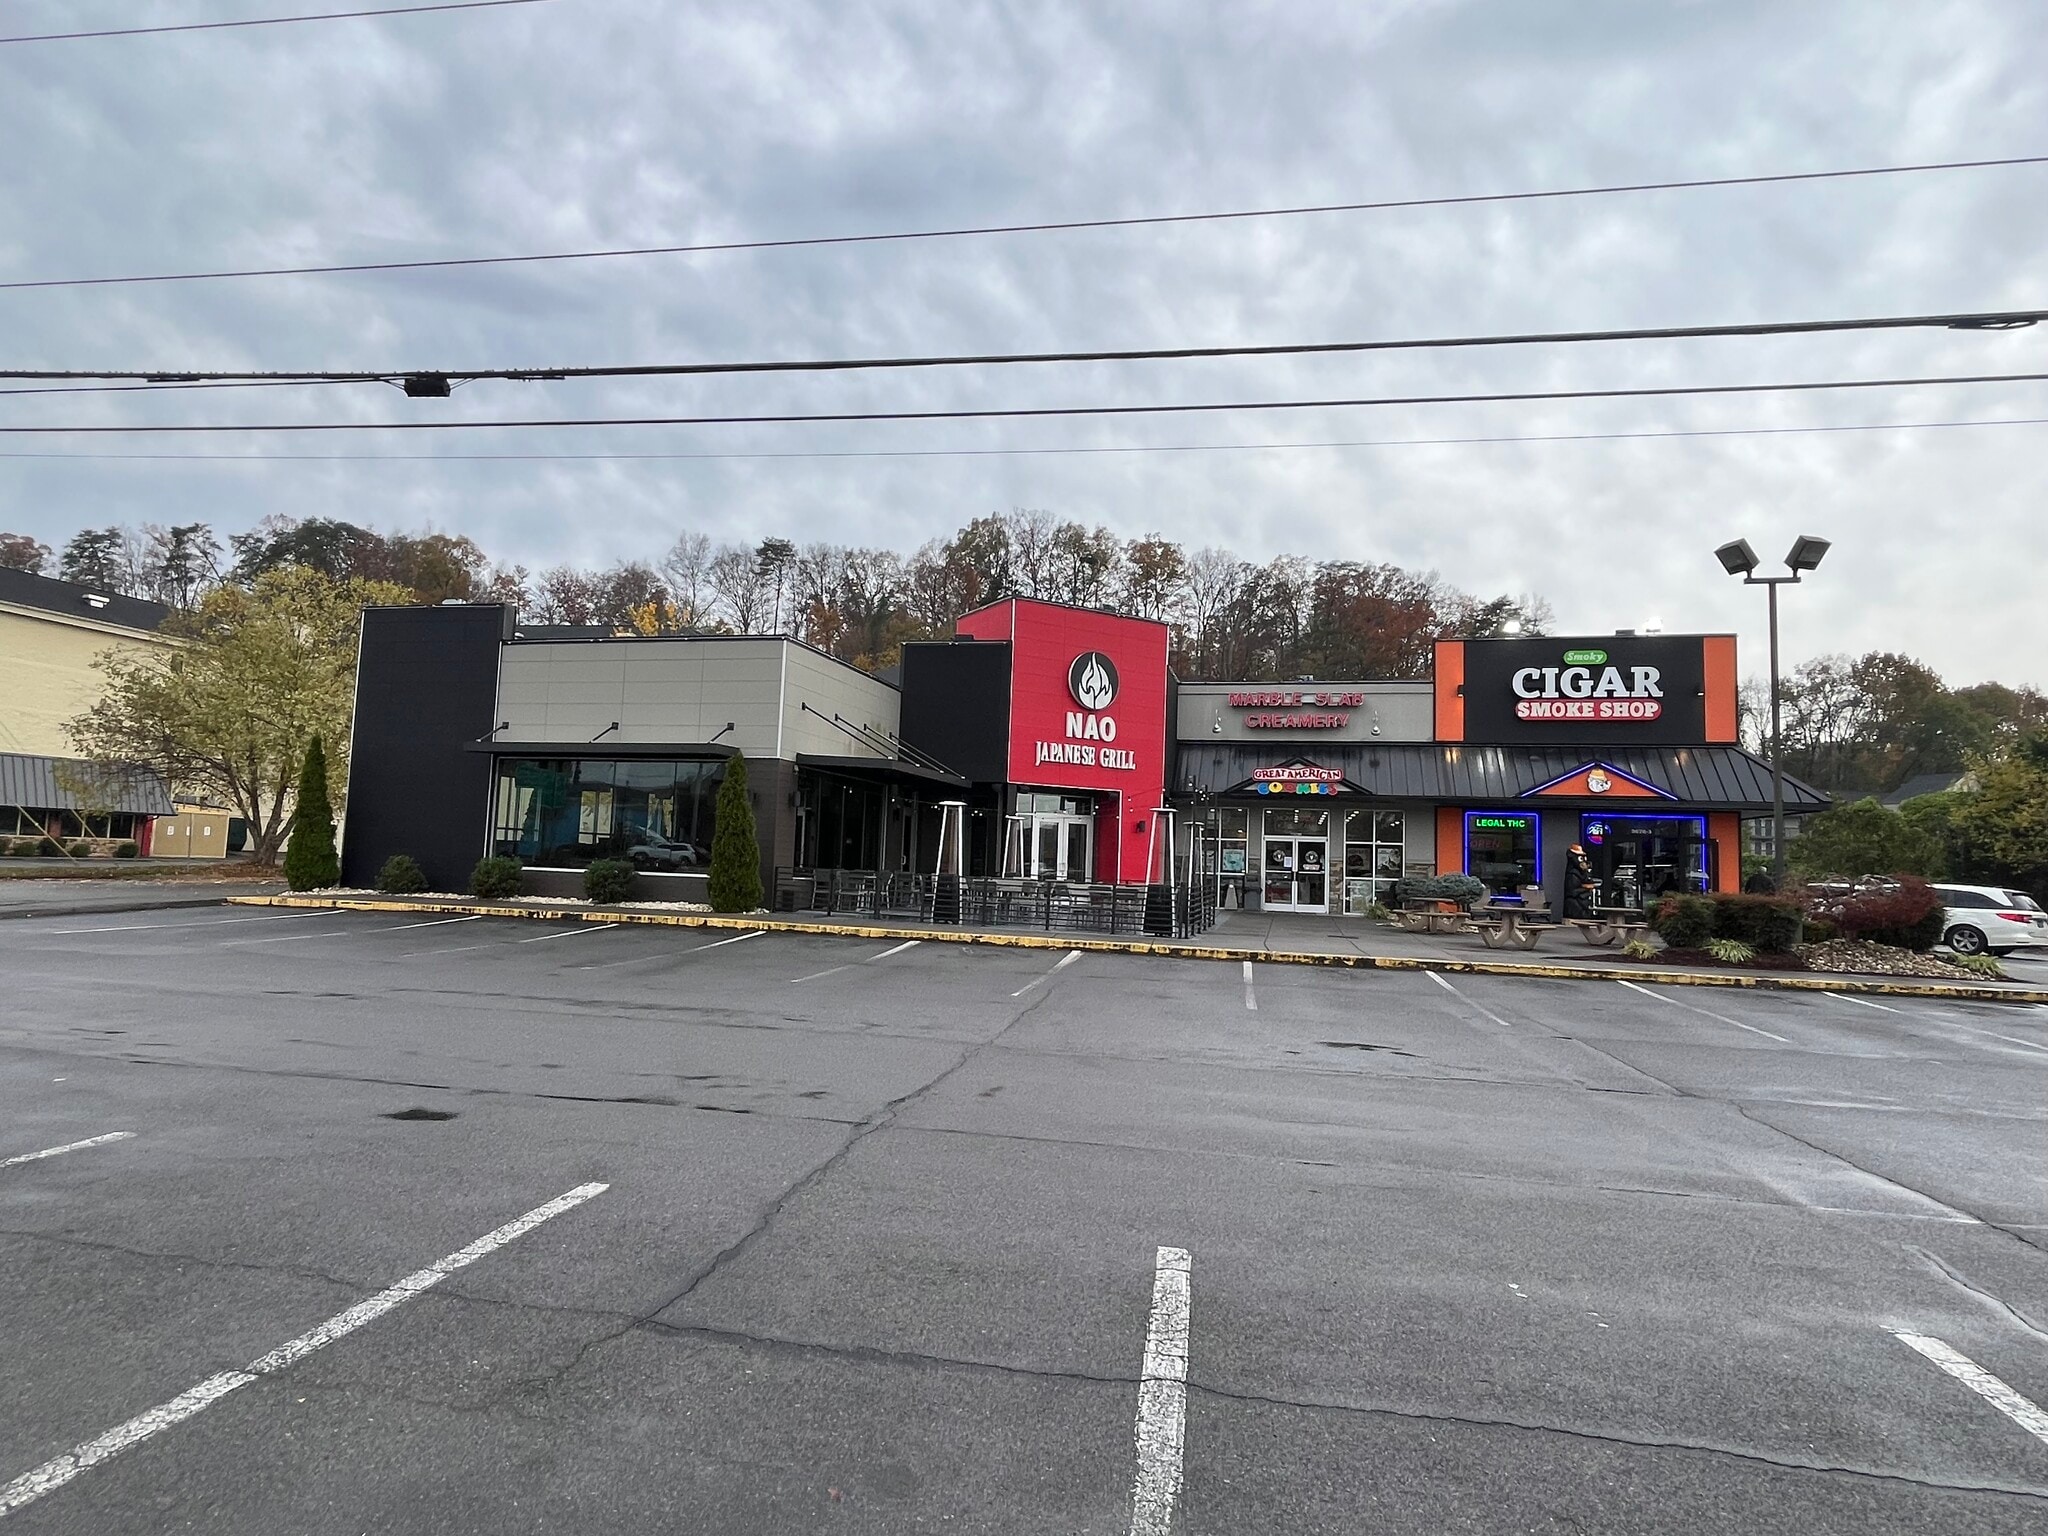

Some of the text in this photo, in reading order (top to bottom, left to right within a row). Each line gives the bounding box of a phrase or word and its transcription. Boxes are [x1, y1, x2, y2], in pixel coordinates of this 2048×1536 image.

[1567, 652, 1604, 663] Smoky
[1512, 667, 1664, 699] CIGAR
[1228, 692, 1364, 706] MARBLE SLAB
[1517, 702, 1660, 718] SMOKE SHOP
[1065, 711, 1117, 742] NAO
[1245, 713, 1350, 728] CREAMERY
[1035, 741, 1136, 770] JAPANESE GRILL
[1255, 768, 1340, 780] GREAT AMERICAN
[1257, 782, 1338, 796] COOKIES
[1476, 819, 1526, 828] LEGAL THC
